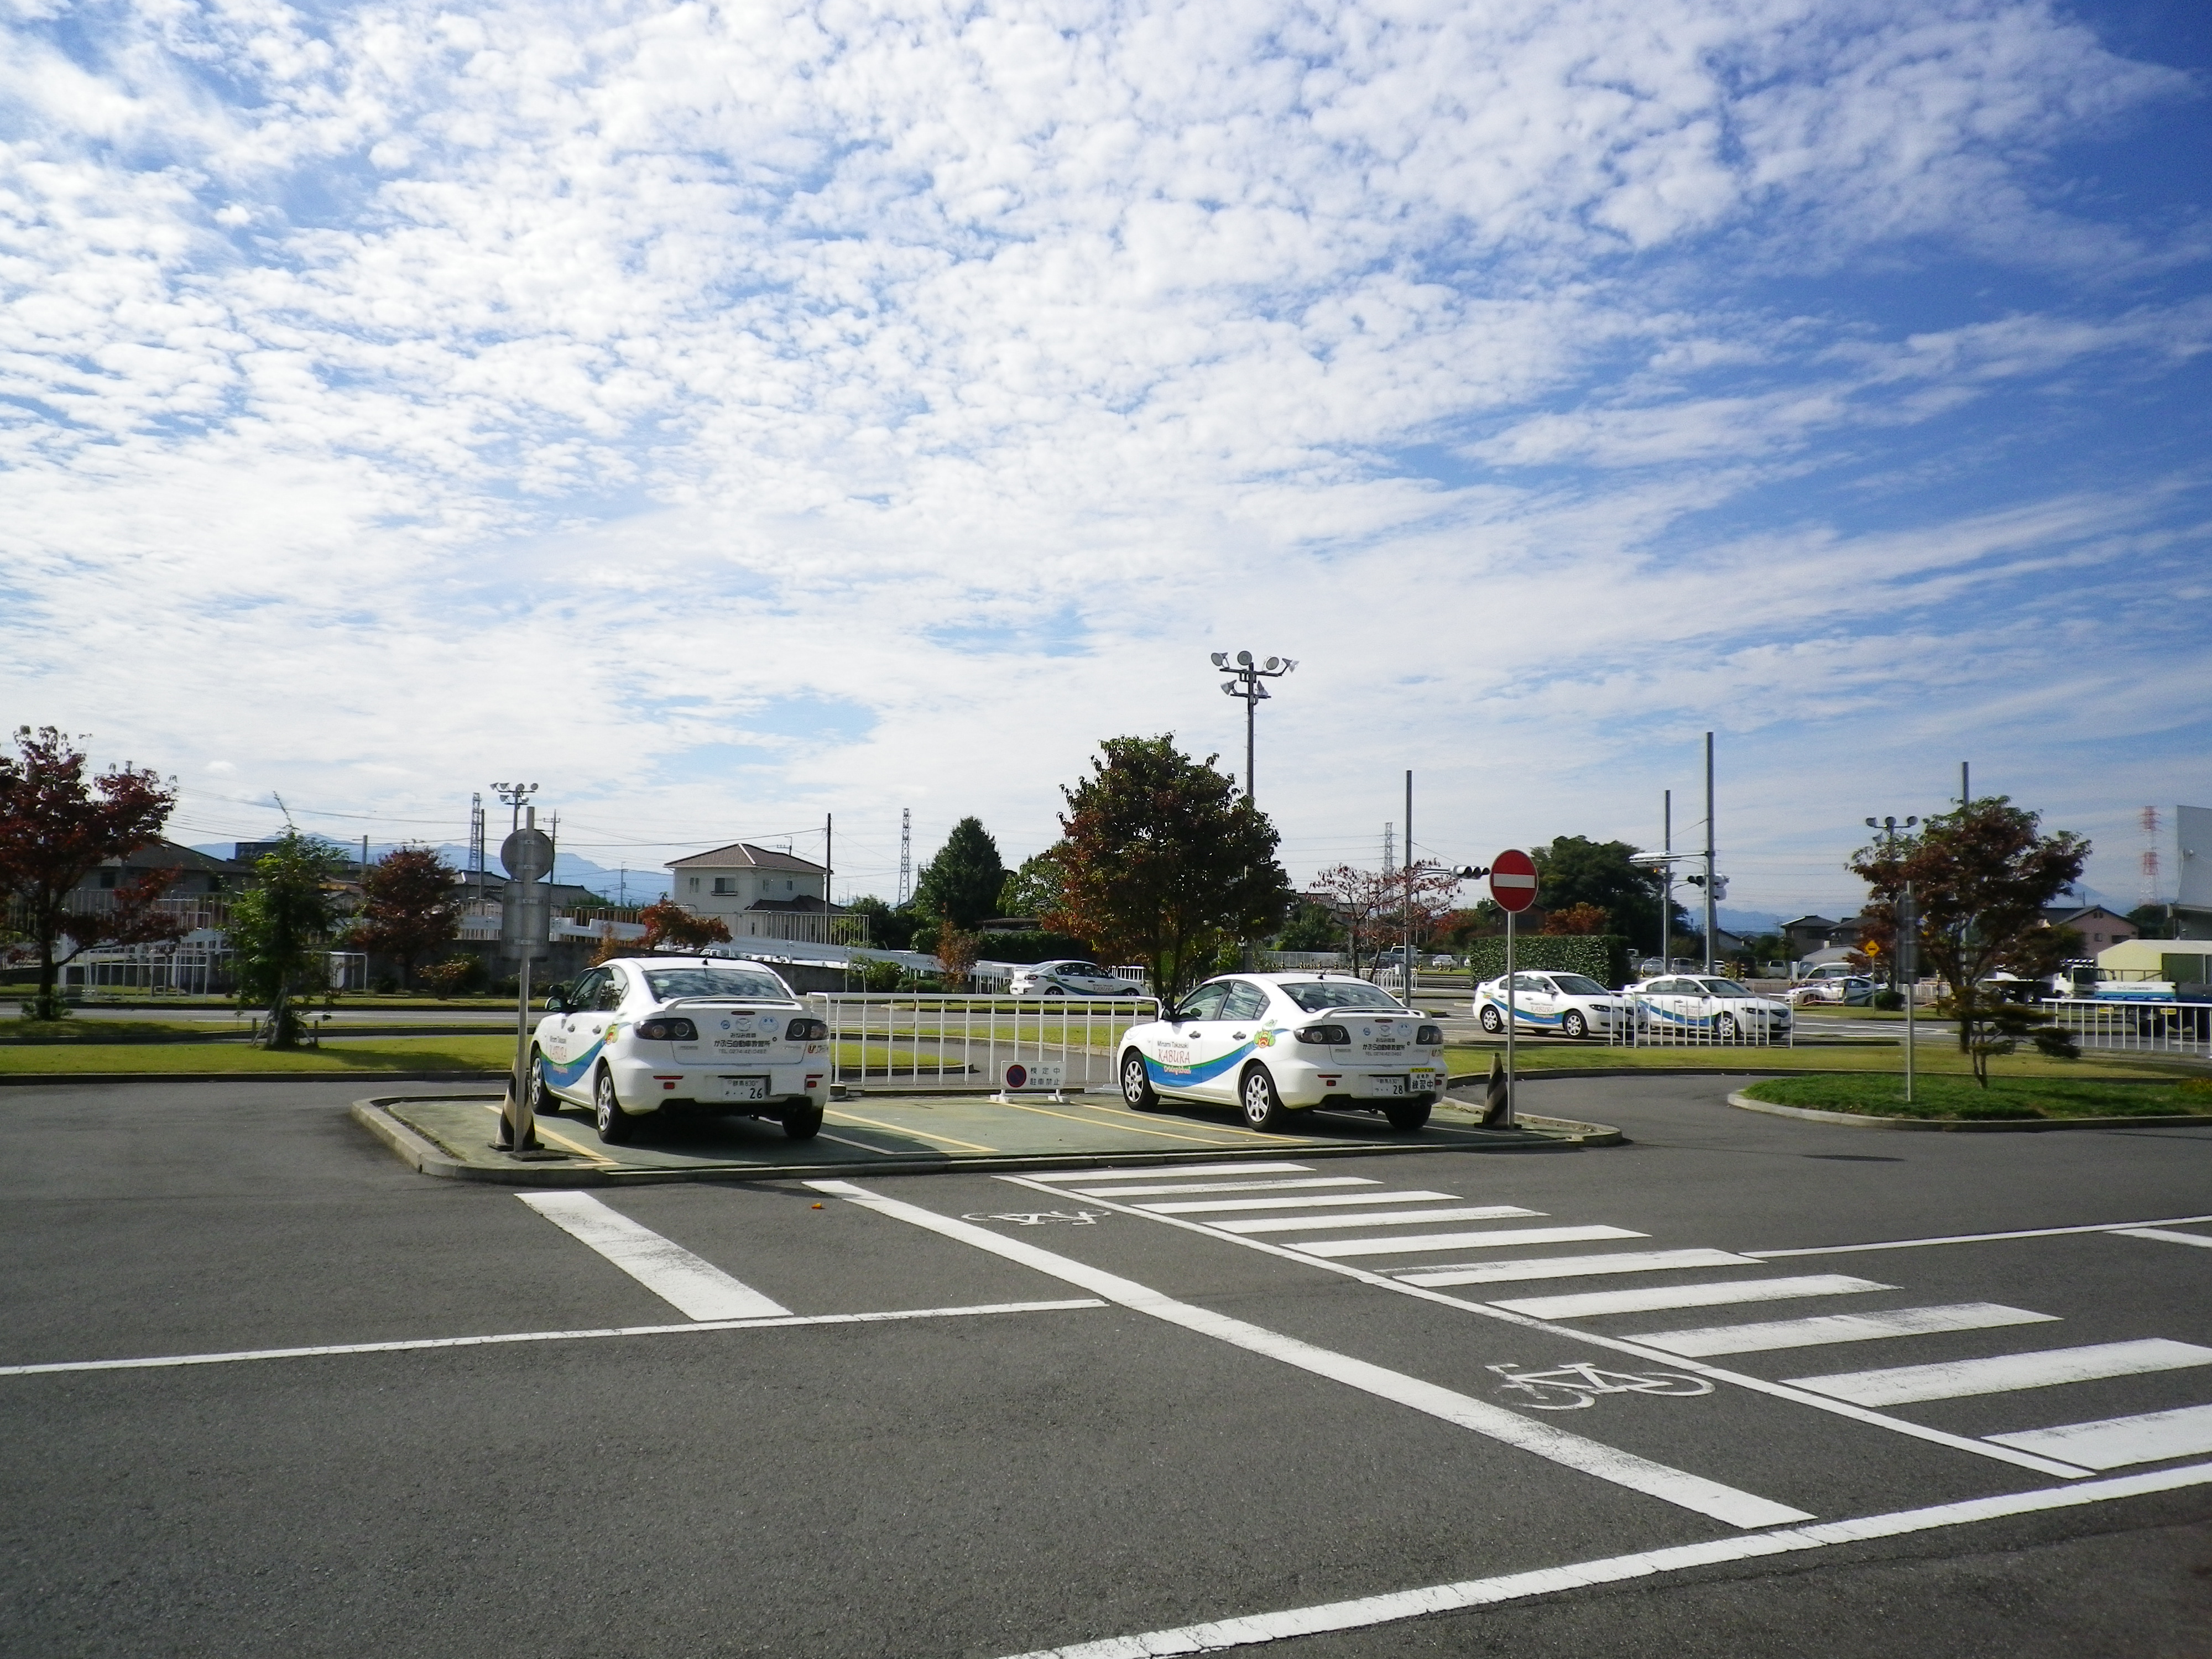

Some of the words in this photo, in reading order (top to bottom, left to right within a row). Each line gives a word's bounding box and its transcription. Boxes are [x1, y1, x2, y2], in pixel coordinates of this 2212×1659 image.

[1158, 1048, 1191, 1065] KABURA
[1030, 1067, 1061, 1075] 検定中
[1394, 1085, 1404, 1095] 28
[1412, 1079, 1434, 1090] 練習中
[749, 1087, 763, 1099] 26
